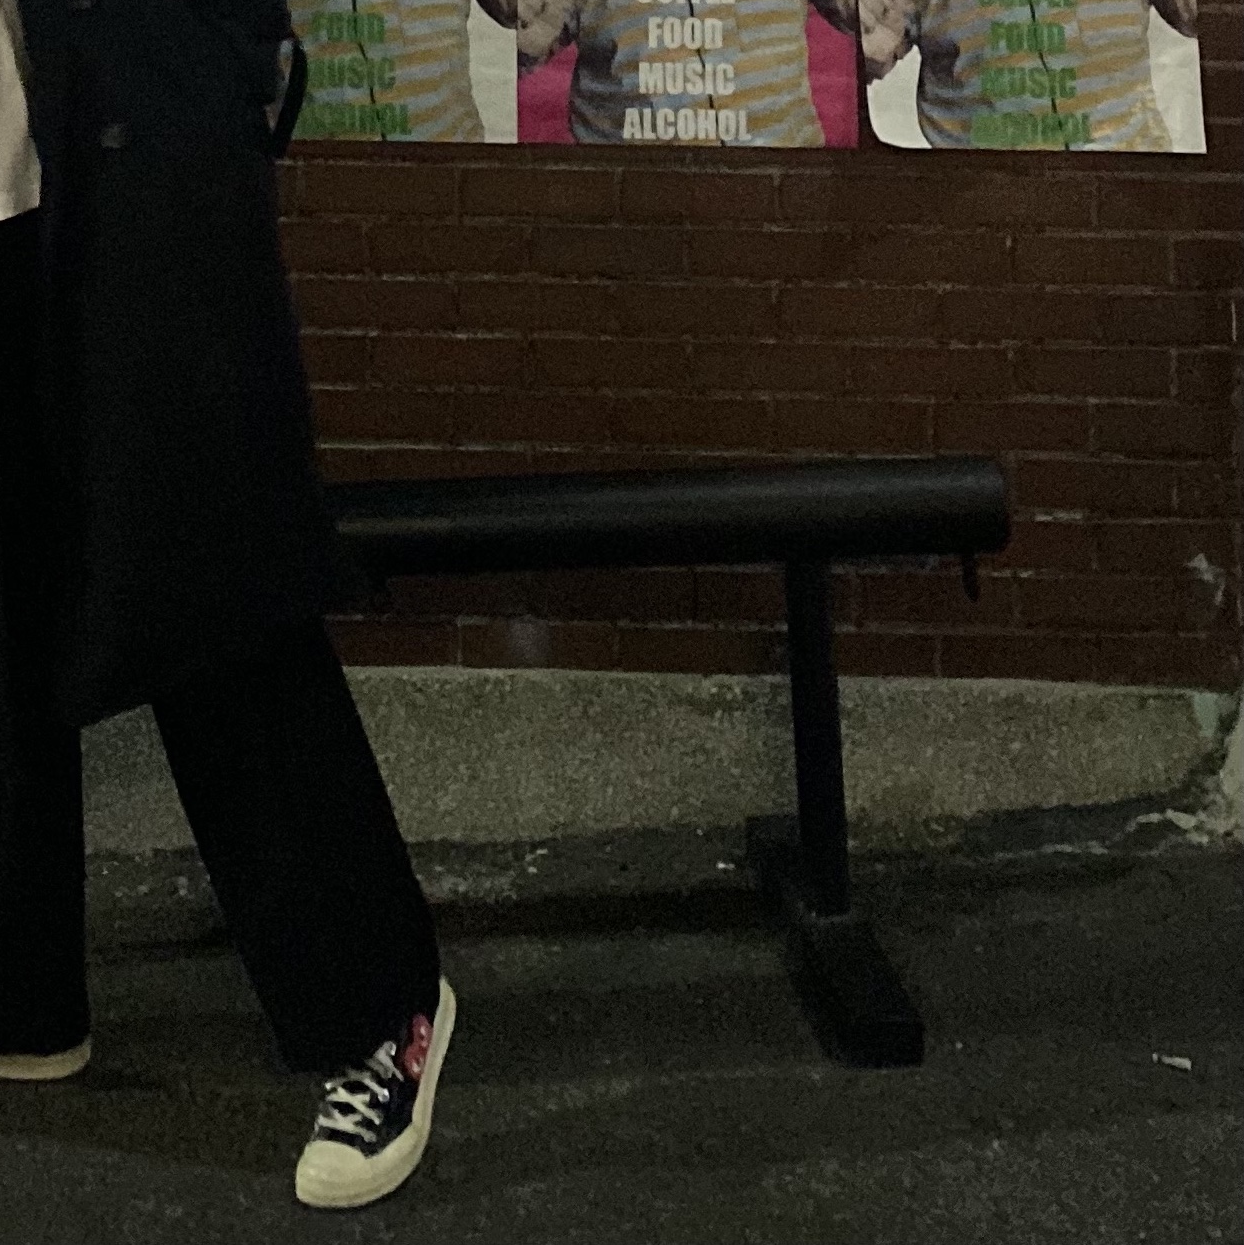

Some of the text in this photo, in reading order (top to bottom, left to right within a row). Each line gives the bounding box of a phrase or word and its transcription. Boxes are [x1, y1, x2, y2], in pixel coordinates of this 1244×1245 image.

[648, 17, 722, 50] FOOD
[991, 22, 1066, 53] FOOD
[638, 62, 735, 95] MUSIC
[981, 68, 1076, 98] MUSIC
[623, 108, 751, 141] ALCOHOL
